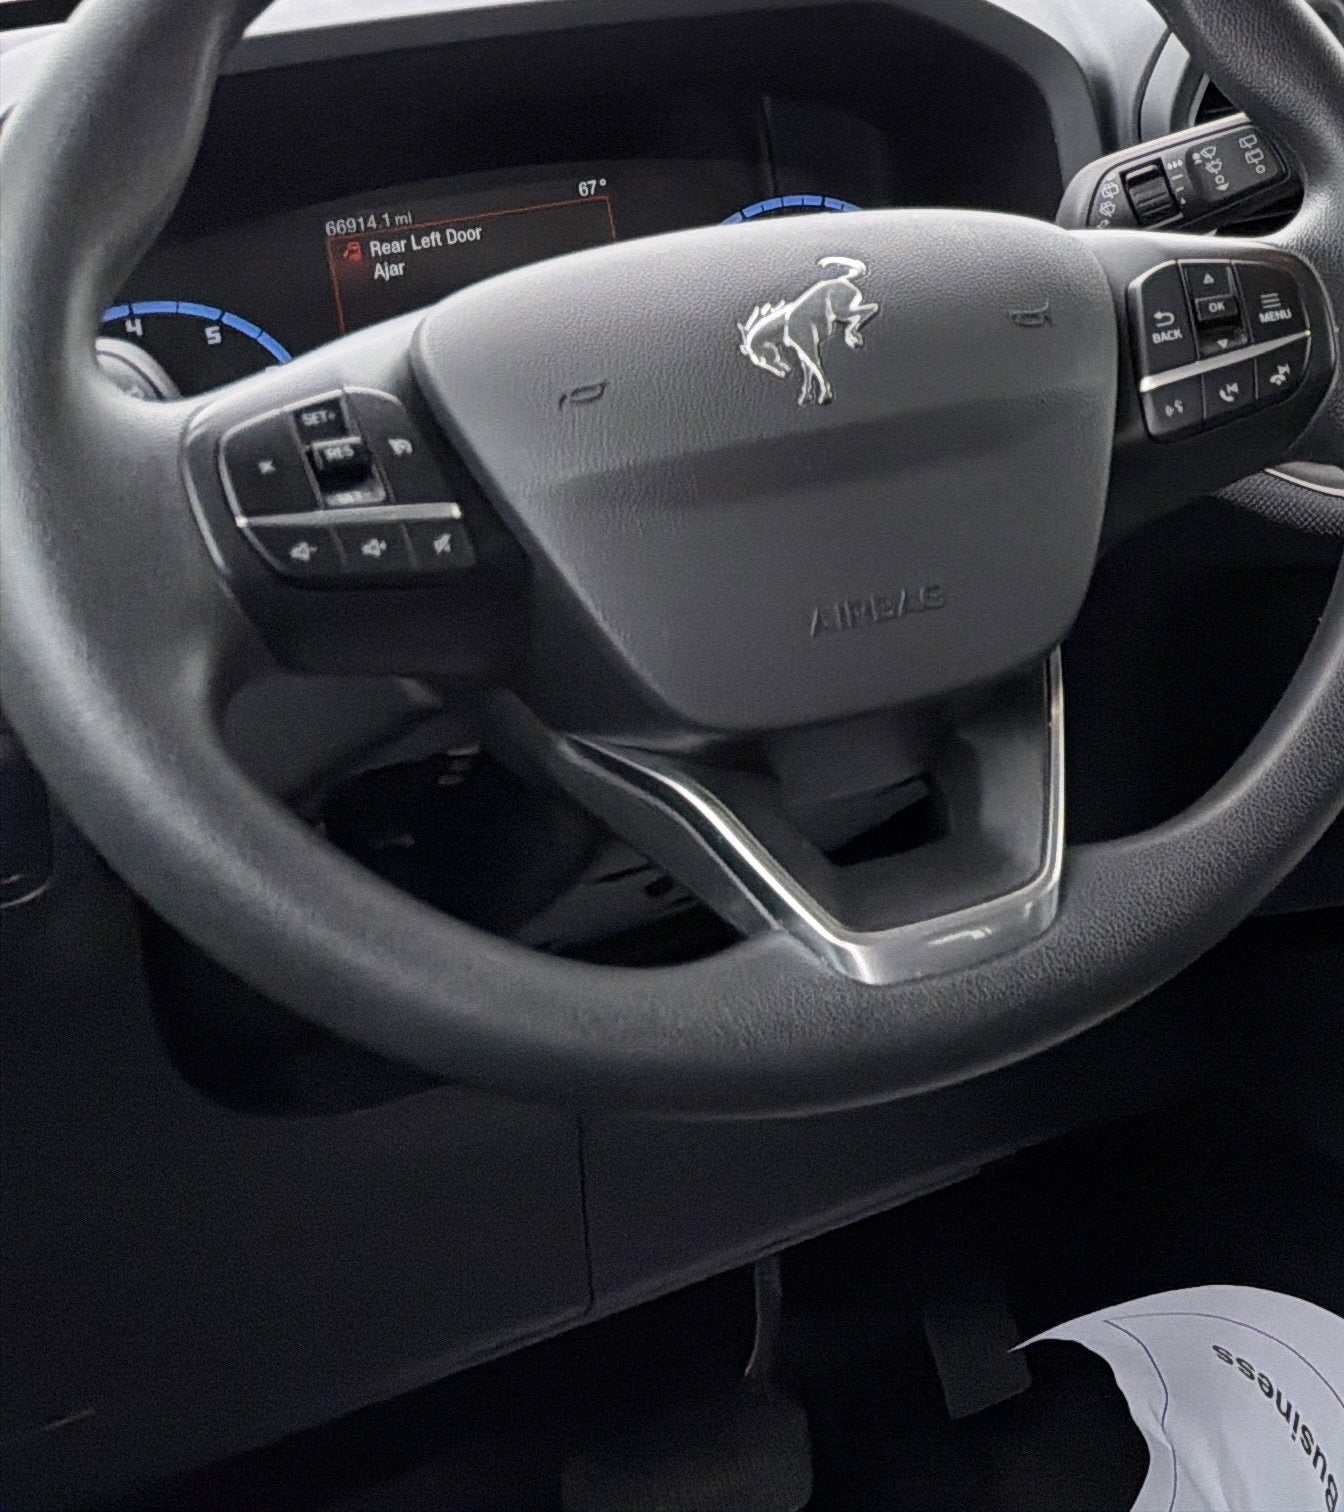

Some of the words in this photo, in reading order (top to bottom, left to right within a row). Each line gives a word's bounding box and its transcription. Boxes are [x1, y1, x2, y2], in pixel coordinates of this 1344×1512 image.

[325, 213, 392, 237] 66914.1
[369, 240, 407, 257] Rear
[411, 233, 443, 251] Left
[446, 226, 483, 245] Door
[374, 261, 406, 281] Ajar
[1208, 301, 1226, 313] OK
[1259, 307, 1292, 323] MENU
[204, 326, 222, 345] 5
[1152, 329, 1183, 344] BACK
